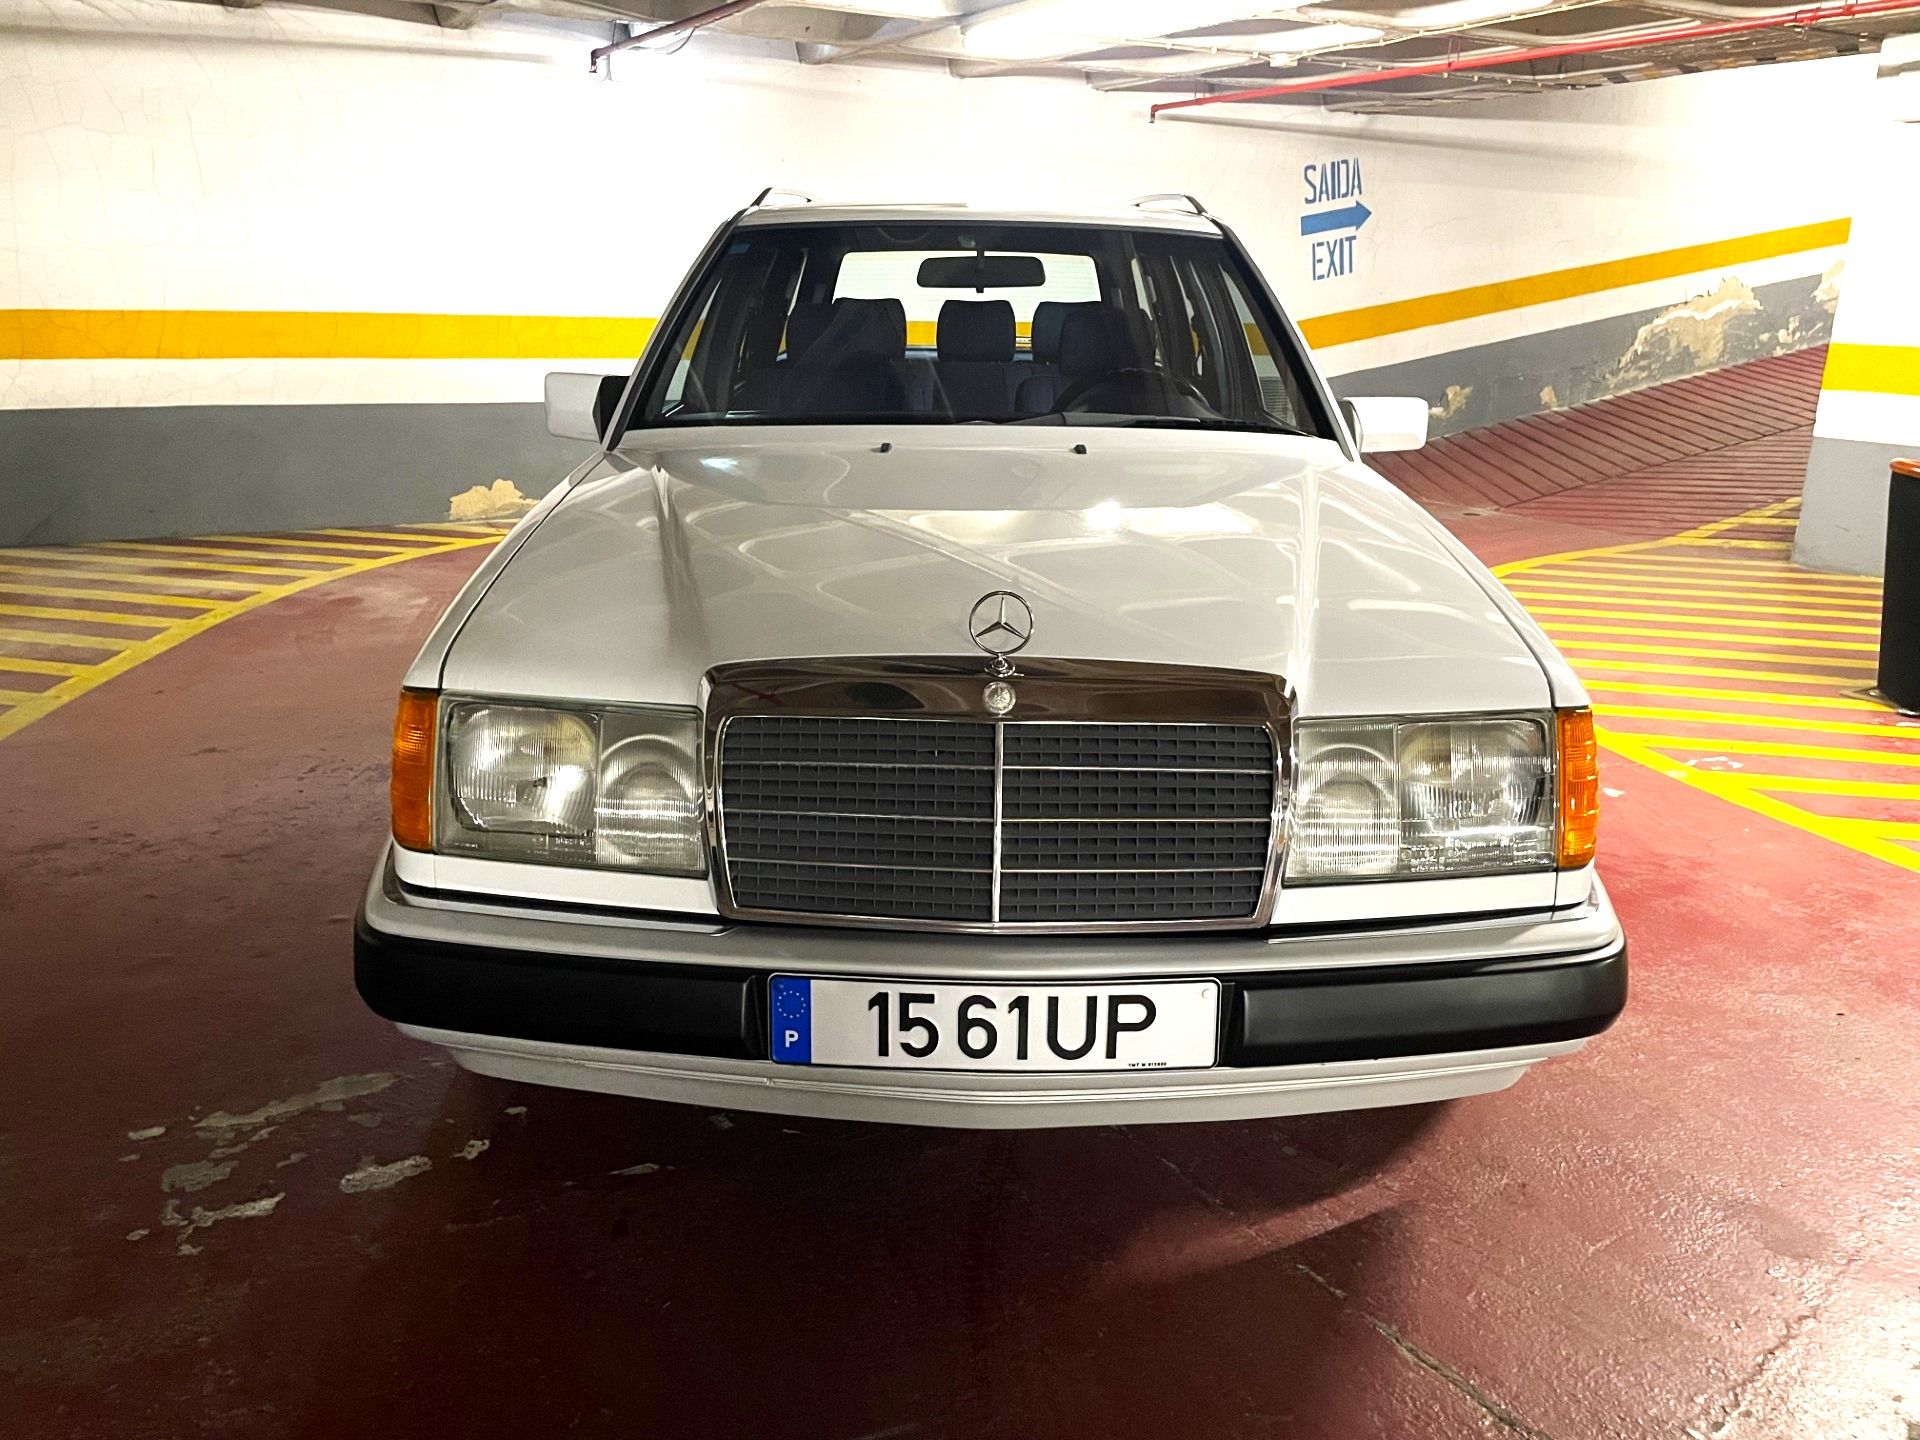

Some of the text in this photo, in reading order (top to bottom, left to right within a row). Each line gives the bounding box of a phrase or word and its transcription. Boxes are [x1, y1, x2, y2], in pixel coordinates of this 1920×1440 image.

[1304, 157, 1362, 204] SAIDA
[1312, 235, 1356, 281] EXIT
[785, 1030, 799, 1048] P
[868, 991, 939, 1058] 15
